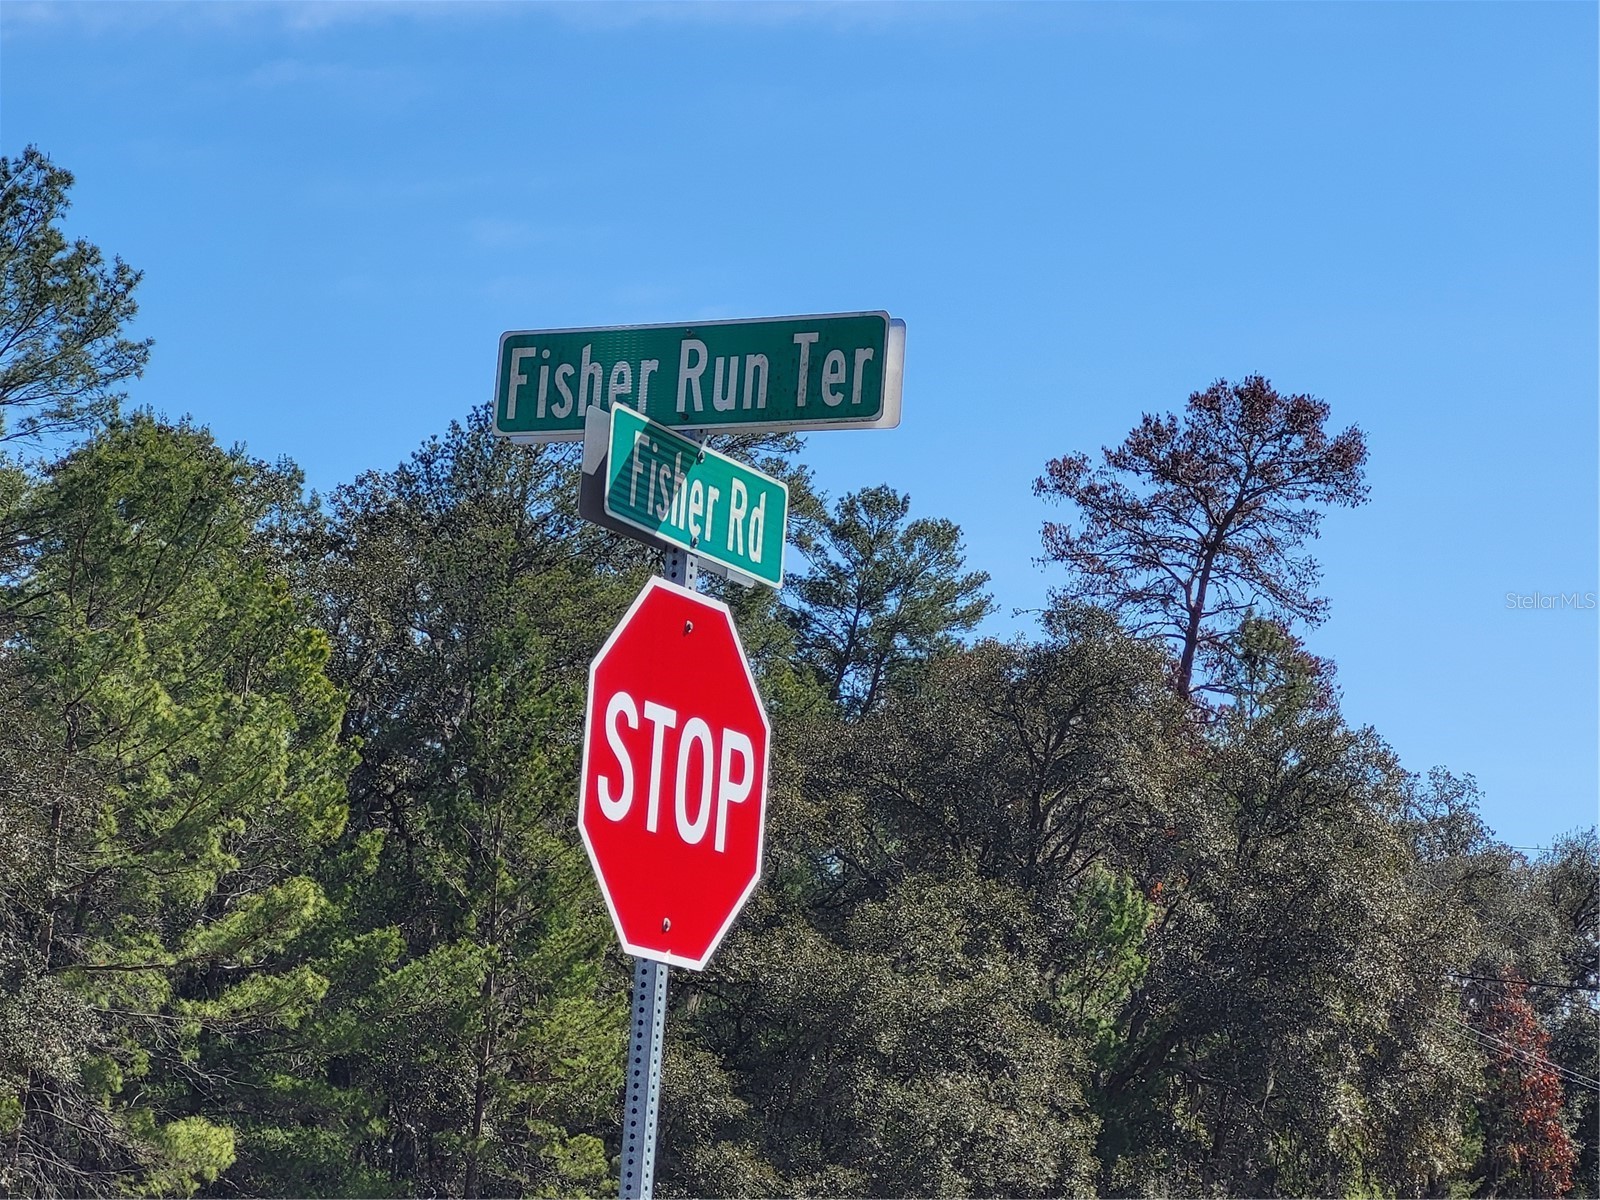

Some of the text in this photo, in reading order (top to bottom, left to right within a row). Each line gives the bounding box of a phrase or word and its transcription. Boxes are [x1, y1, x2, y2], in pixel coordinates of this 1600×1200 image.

[506, 332, 875, 420] Fisher Run Ter
[629, 430, 767, 564] Fisher Rd
[597, 691, 754, 853] STOP
